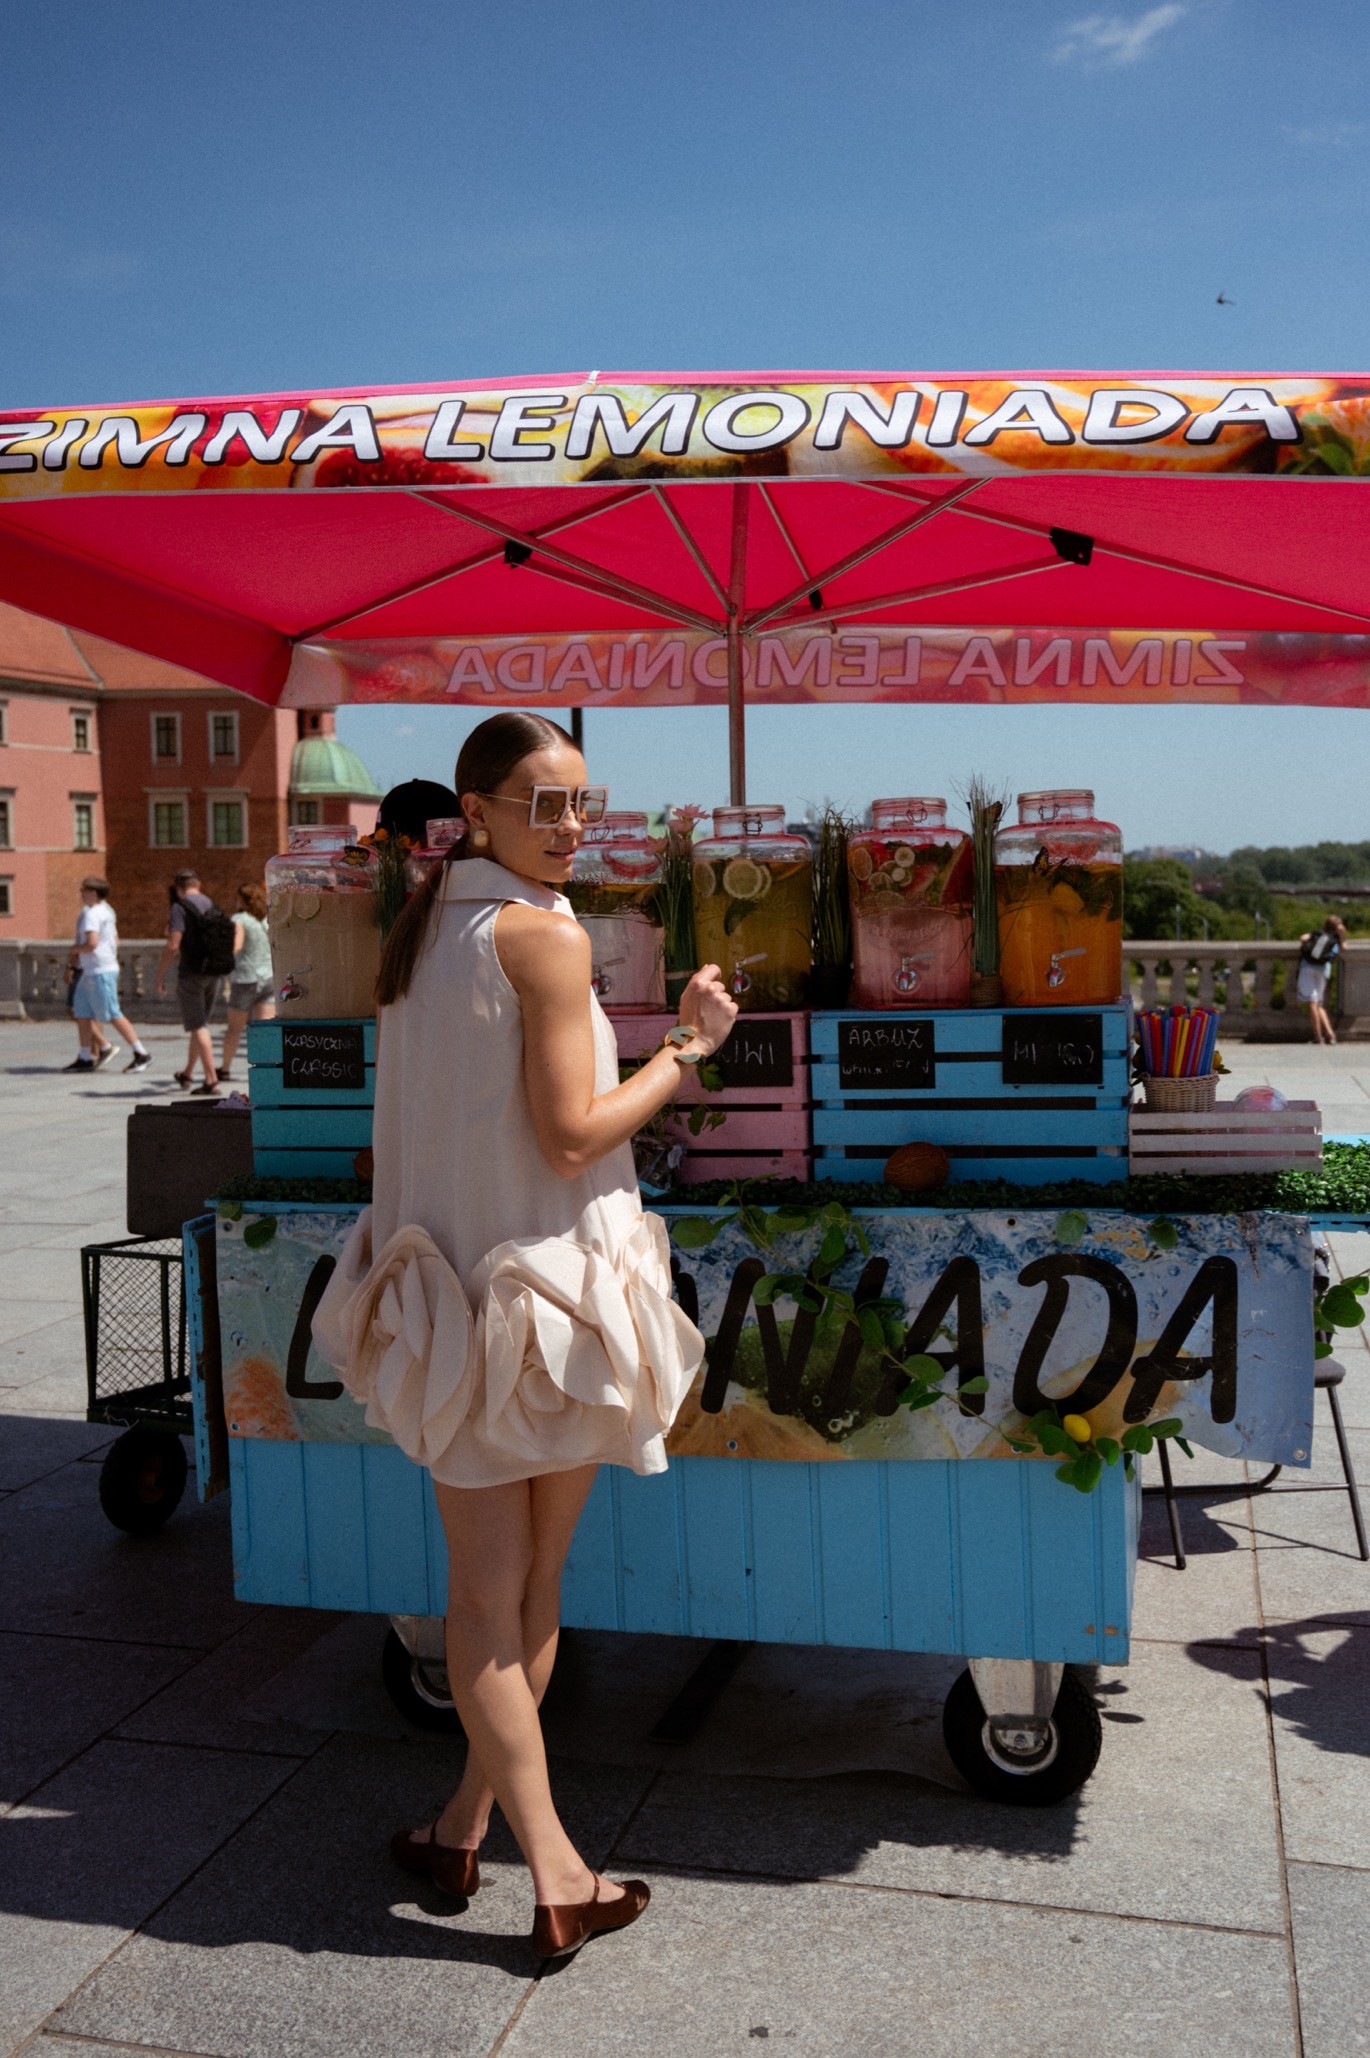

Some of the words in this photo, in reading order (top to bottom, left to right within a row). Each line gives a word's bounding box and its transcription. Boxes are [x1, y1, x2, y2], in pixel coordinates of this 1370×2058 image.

[0, 404, 384, 473] ZIMNA
[423, 387, 1303, 463] LEMONIADA
[849, 1027, 923, 1050] ARBUZ
[291, 1057, 357, 1079] CLASSIC
